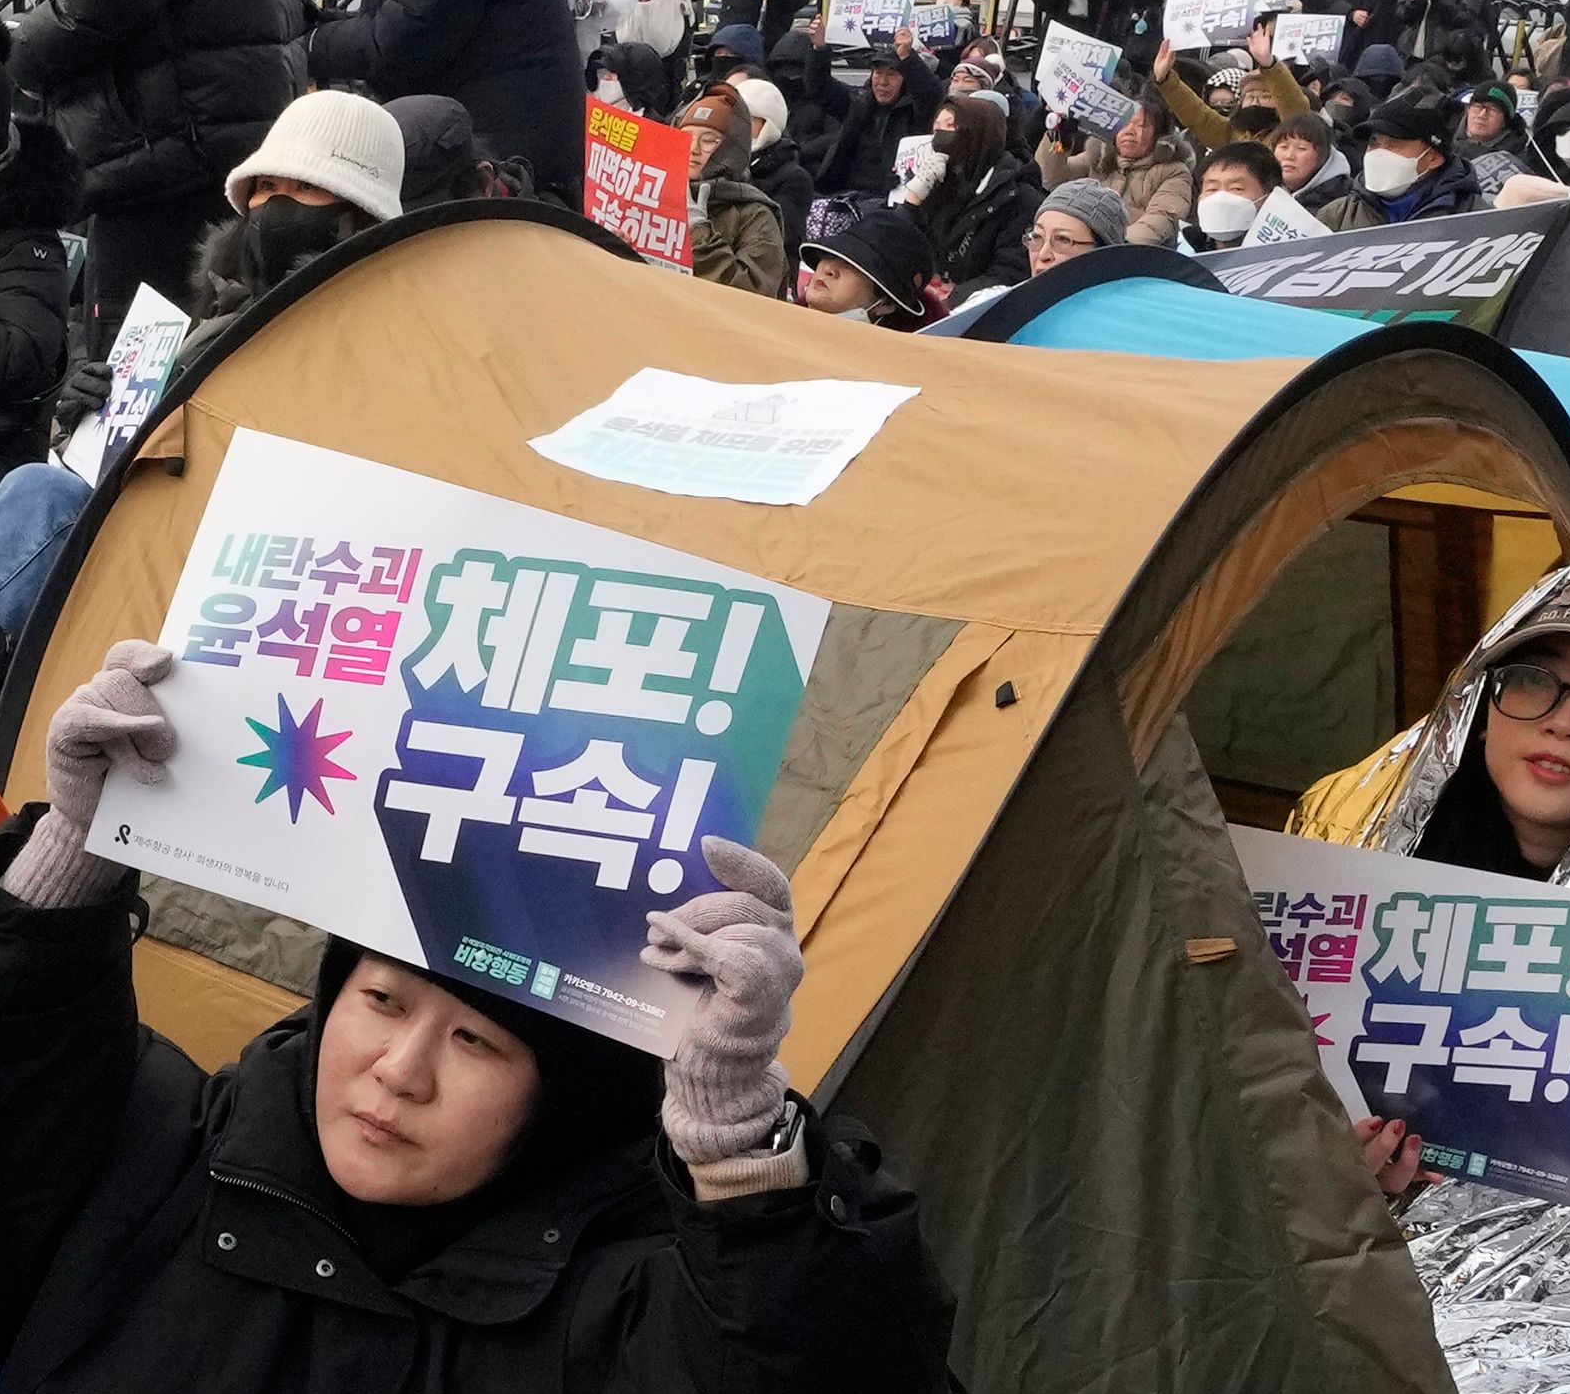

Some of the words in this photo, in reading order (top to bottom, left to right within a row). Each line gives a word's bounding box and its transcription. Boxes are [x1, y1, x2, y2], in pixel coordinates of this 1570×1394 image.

[586, 140, 667, 210] 파면하고
[590, 187, 685, 261] 구속하라!
[602, 415, 688, 445] 윤석열
[774, 433, 844, 457] 위한
[211, 530, 424, 606] 내란수괴
[182, 591, 403, 687] 윤석열
[415, 560, 761, 737] 체포!
[383, 720, 715, 896] 구속!
[263, 875, 290, 894] 빕니다
[1252, 891, 1369, 931] 란수괴
[453, 943, 531, 987] 비상행동
[563, 972, 602, 995] 카카오뱅크
[1270, 931, 1359, 984] 석열
